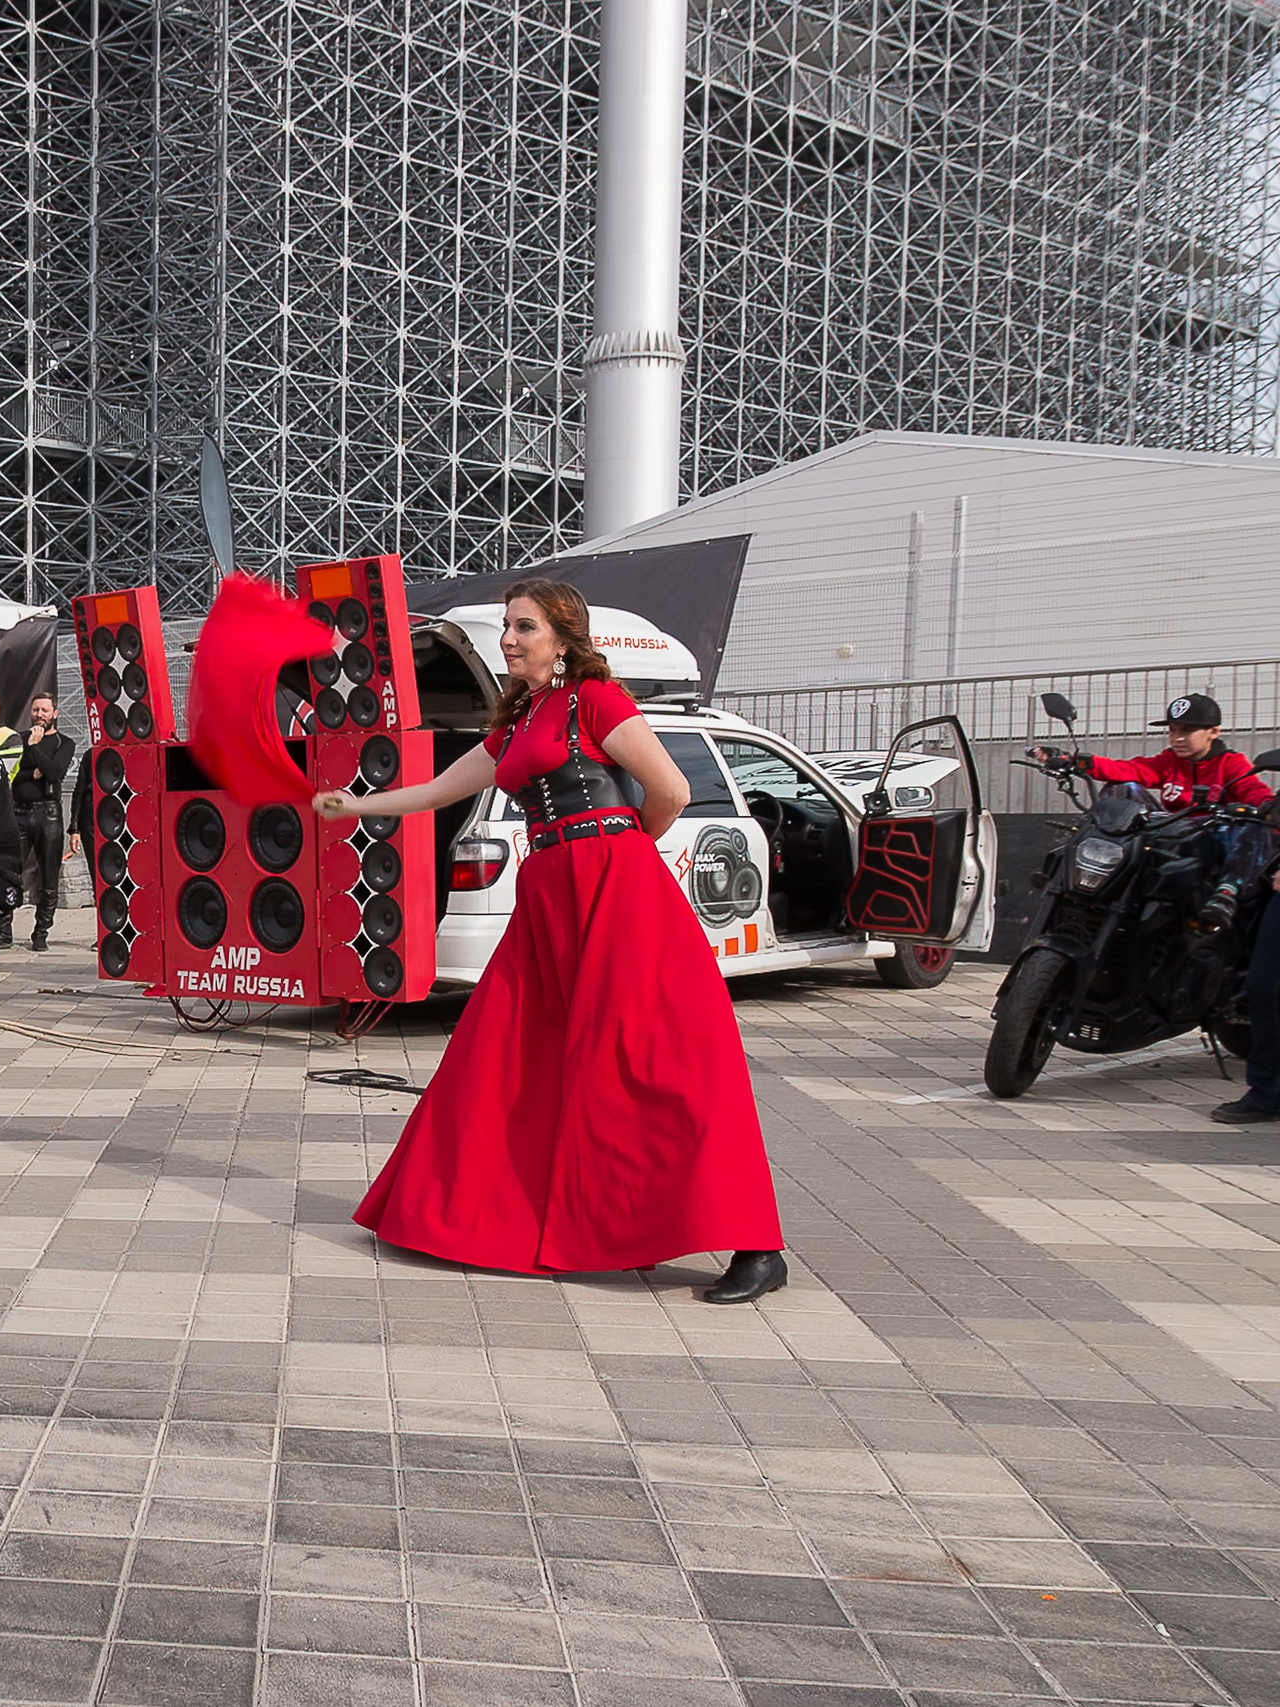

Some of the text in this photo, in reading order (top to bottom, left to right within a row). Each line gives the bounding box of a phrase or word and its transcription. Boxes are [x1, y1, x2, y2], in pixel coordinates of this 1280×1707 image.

[590, 636, 622, 648] EAM
[381, 680, 397, 728] AMP
[90, 702, 102, 744] AMP
[1163, 782, 1184, 802] 25
[694, 862, 726, 873] POWER
[695, 853, 715, 863] MAX
[210, 945, 261, 970] AMP
[177, 970, 227, 993] TEAM
